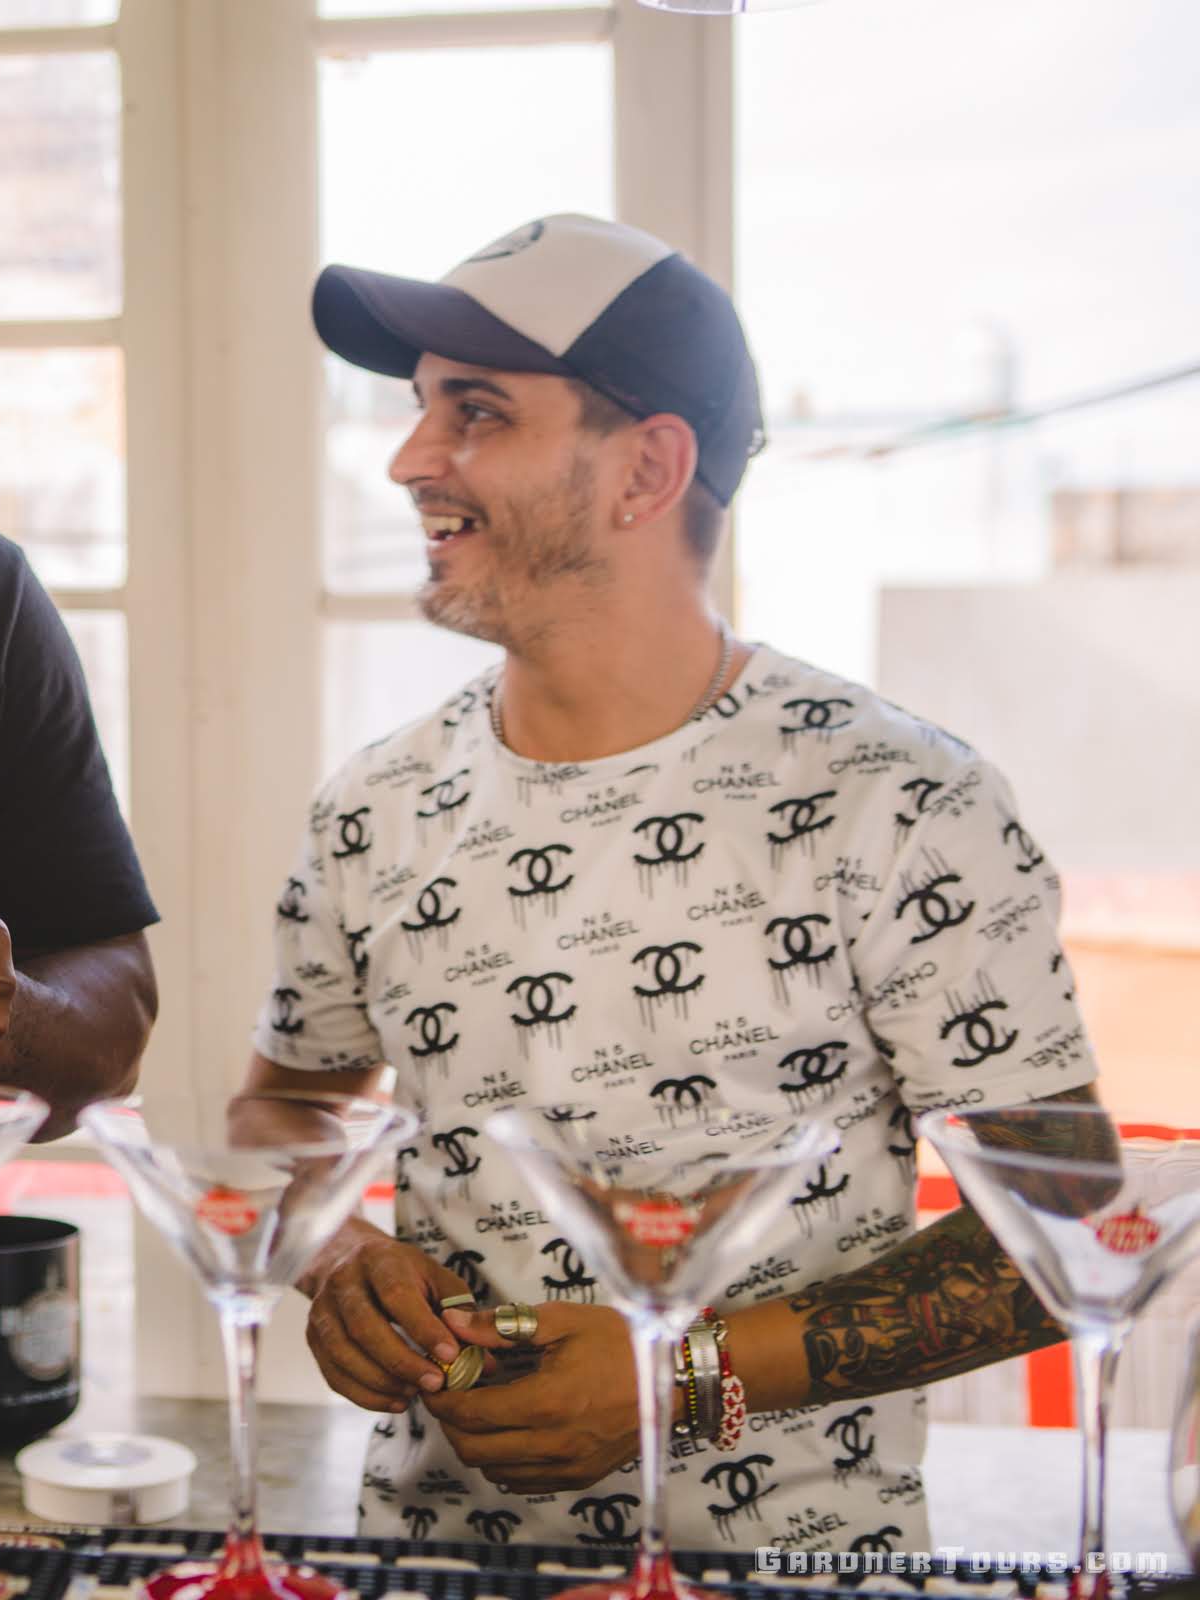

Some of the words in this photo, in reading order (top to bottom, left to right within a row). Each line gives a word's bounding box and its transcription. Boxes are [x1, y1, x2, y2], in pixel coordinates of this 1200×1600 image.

[828, 750, 916, 775] CHANEL
[693, 772, 781, 794] CHANEL
[560, 792, 643, 824] CHANEL
[456, 825, 515, 854] HANEL
[557, 920, 640, 951] CHANEL
[444, 951, 514, 983] CHANEL
[715, 1019, 729, 1031] N
[737, 1016, 747, 1028] 5
[595, 1047, 607, 1059] N
[613, 1044, 623, 1056] 5
[689, 1025, 780, 1056] CHANEL
[571, 1052, 654, 1083] CHANEL
[595, 1139, 663, 1162] CHANEL
[608, 1136, 621, 1146] N
[624, 1133, 634, 1144] 5
[490, 1203, 503, 1213] N
[509, 1200, 521, 1211] 5
[476, 1210, 549, 1234] CHANEL
[726, 1259, 799, 1299] CHANEL
[787, 1513, 802, 1527] N
[805, 1507, 817, 1519] 5
[770, 1512, 849, 1550] CHANEL
